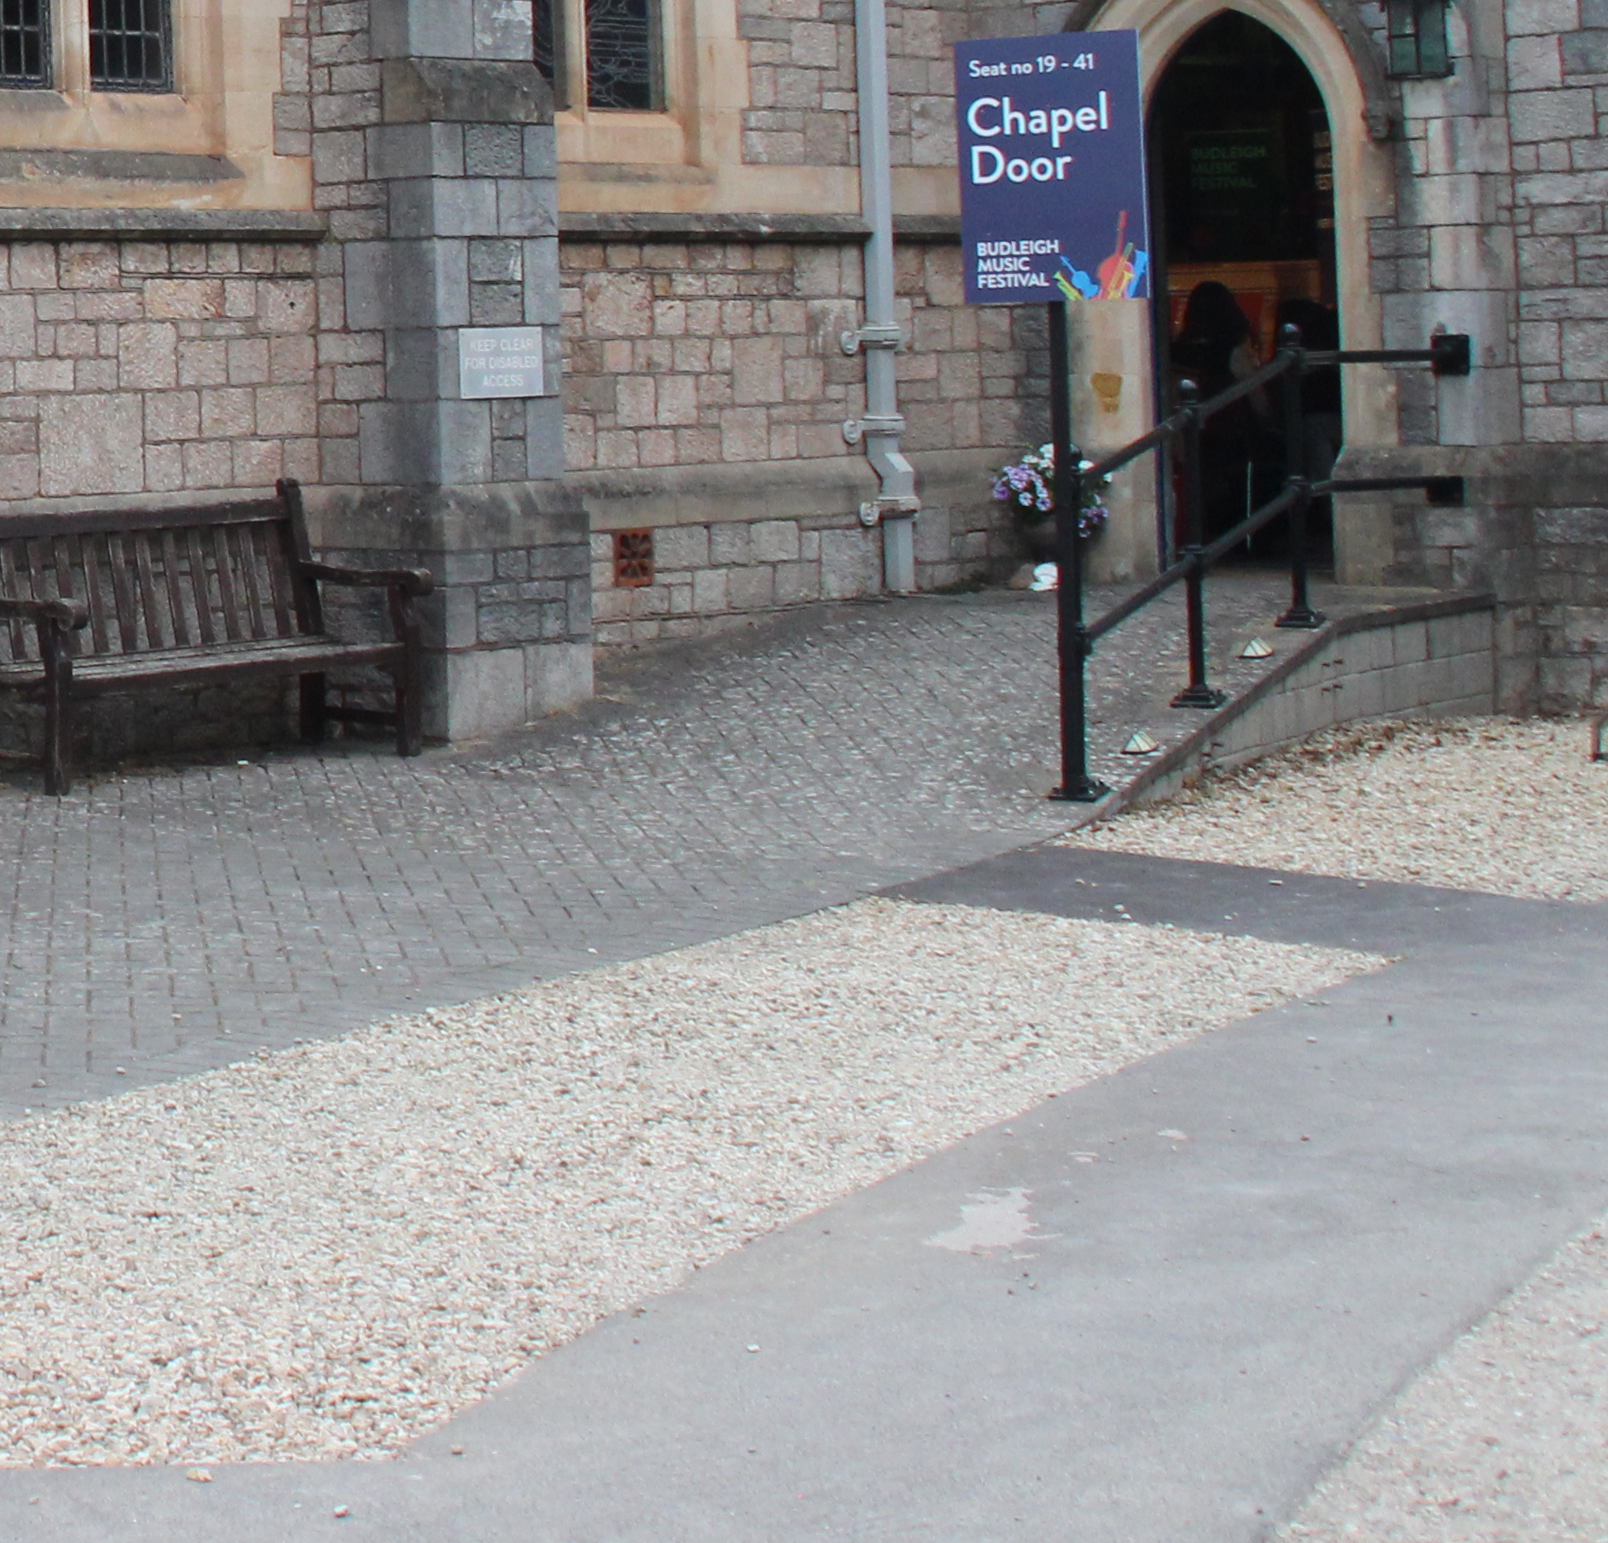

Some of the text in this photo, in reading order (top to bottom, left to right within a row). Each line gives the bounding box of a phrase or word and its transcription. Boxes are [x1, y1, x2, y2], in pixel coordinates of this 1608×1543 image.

[969, 59, 1007, 78] Seat
[1011, 62, 1032, 75] no
[1036, 56, 1056, 72] 19
[1073, 53, 1094, 70] 41
[967, 90, 1108, 148] Chapel
[971, 145, 1072, 184] Door
[977, 240, 1059, 257] BUDLEIGH
[978, 257, 1030, 272] MUSIC
[978, 272, 1050, 288] FESTIVAL
[470, 338, 534, 351] KEEP CLEAR
[464, 355, 538, 370] FOR DISABLED
[483, 375, 524, 387] ACCESS
